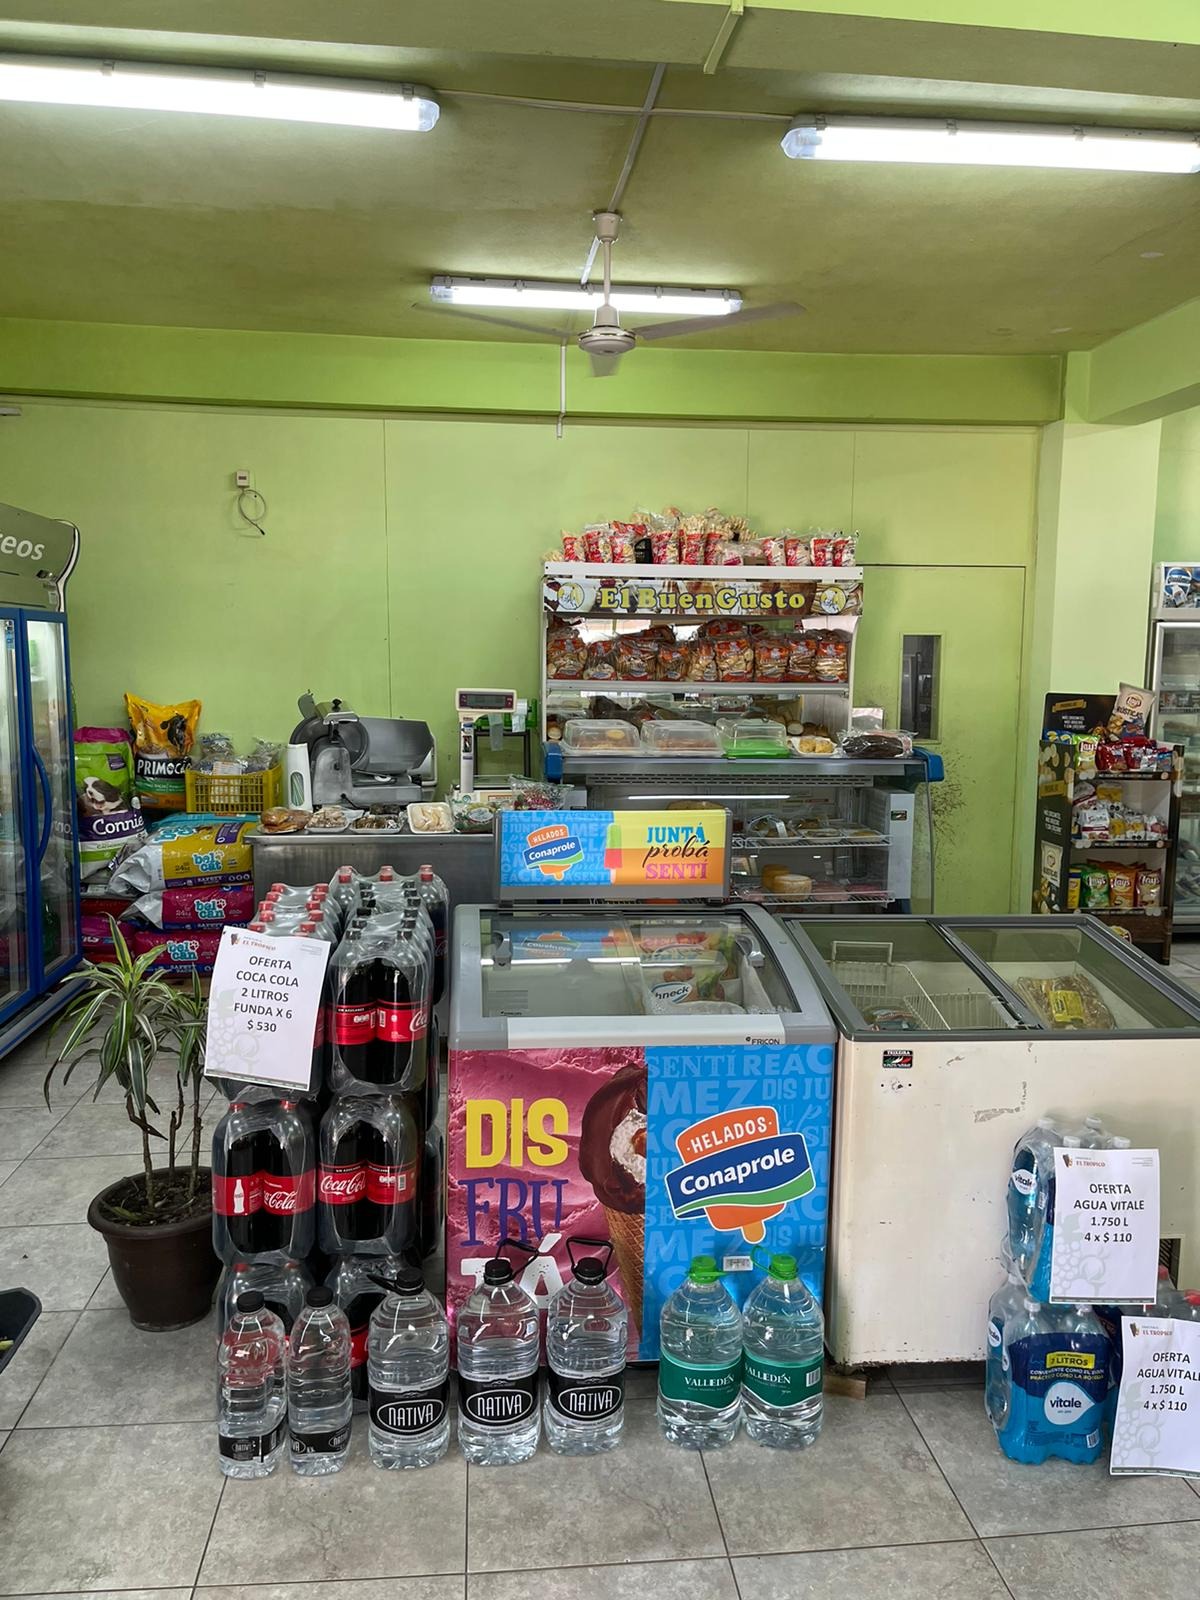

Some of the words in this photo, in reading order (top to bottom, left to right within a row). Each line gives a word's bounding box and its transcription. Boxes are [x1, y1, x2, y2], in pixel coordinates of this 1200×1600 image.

[0, 531, 45, 561] eos
[93, 814, 144, 835] Connie
[532, 829, 565, 843] HELADOS
[647, 822, 706, 843] JUNTÁ
[528, 841, 576, 861] Conaprole
[642, 834, 710, 868] probá
[193, 852, 214, 865] bel
[200, 860, 222, 872] cat
[645, 861, 708, 879] SENTÍ
[195, 900, 217, 910] bel
[199, 910, 225, 919] can
[172, 951, 197, 960] can
[249, 955, 292, 970] OFERTA
[236, 970, 266, 983] COCA
[269, 975, 299, 987] COLA
[241, 987, 248, 997] 2
[251, 988, 289, 1003] LITROS
[234, 1002, 273, 1017] FUNDA
[276, 1008, 283, 1018] X
[286, 1009, 293, 1019] 6
[247, 1019, 253, 1031] $
[256, 1021, 277, 1033] 530
[465, 1097, 569, 1168] DIS
[692, 1117, 767, 1153] HELADOS
[680, 1148, 795, 1195] Conaprole
[1089, 1183, 1132, 1194] OFERTA
[458, 1177, 569, 1247] FRU
[1073, 1199, 1108, 1211] AGUA
[1110, 1200, 1145, 1211] VITALE
[1090, 1216, 1121, 1227] 1.750
[1123, 1217, 1129, 1227] L
[1084, 1233, 1091, 1243] 4
[1103, 1232, 1110, 1243] $
[1113, 1233, 1132, 1243] 110
[1056, 1357, 1089, 1366] LITROS
[1152, 1352, 1191, 1364] OFERTA
[1137, 1368, 1165, 1379] AGUA
[1150, 1384, 1176, 1395] 1.750
[1179, 1385, 1185, 1396] L
[477, 1394, 522, 1417] NATIVA
[569, 1389, 613, 1412] NATIVA
[1050, 1396, 1082, 1408] vitale
[1143, 1400, 1150, 1410] 4
[1159, 1399, 1165, 1411] $
[1167, 1400, 1188, 1412] 110
[388, 1403, 433, 1426] NATIVA
